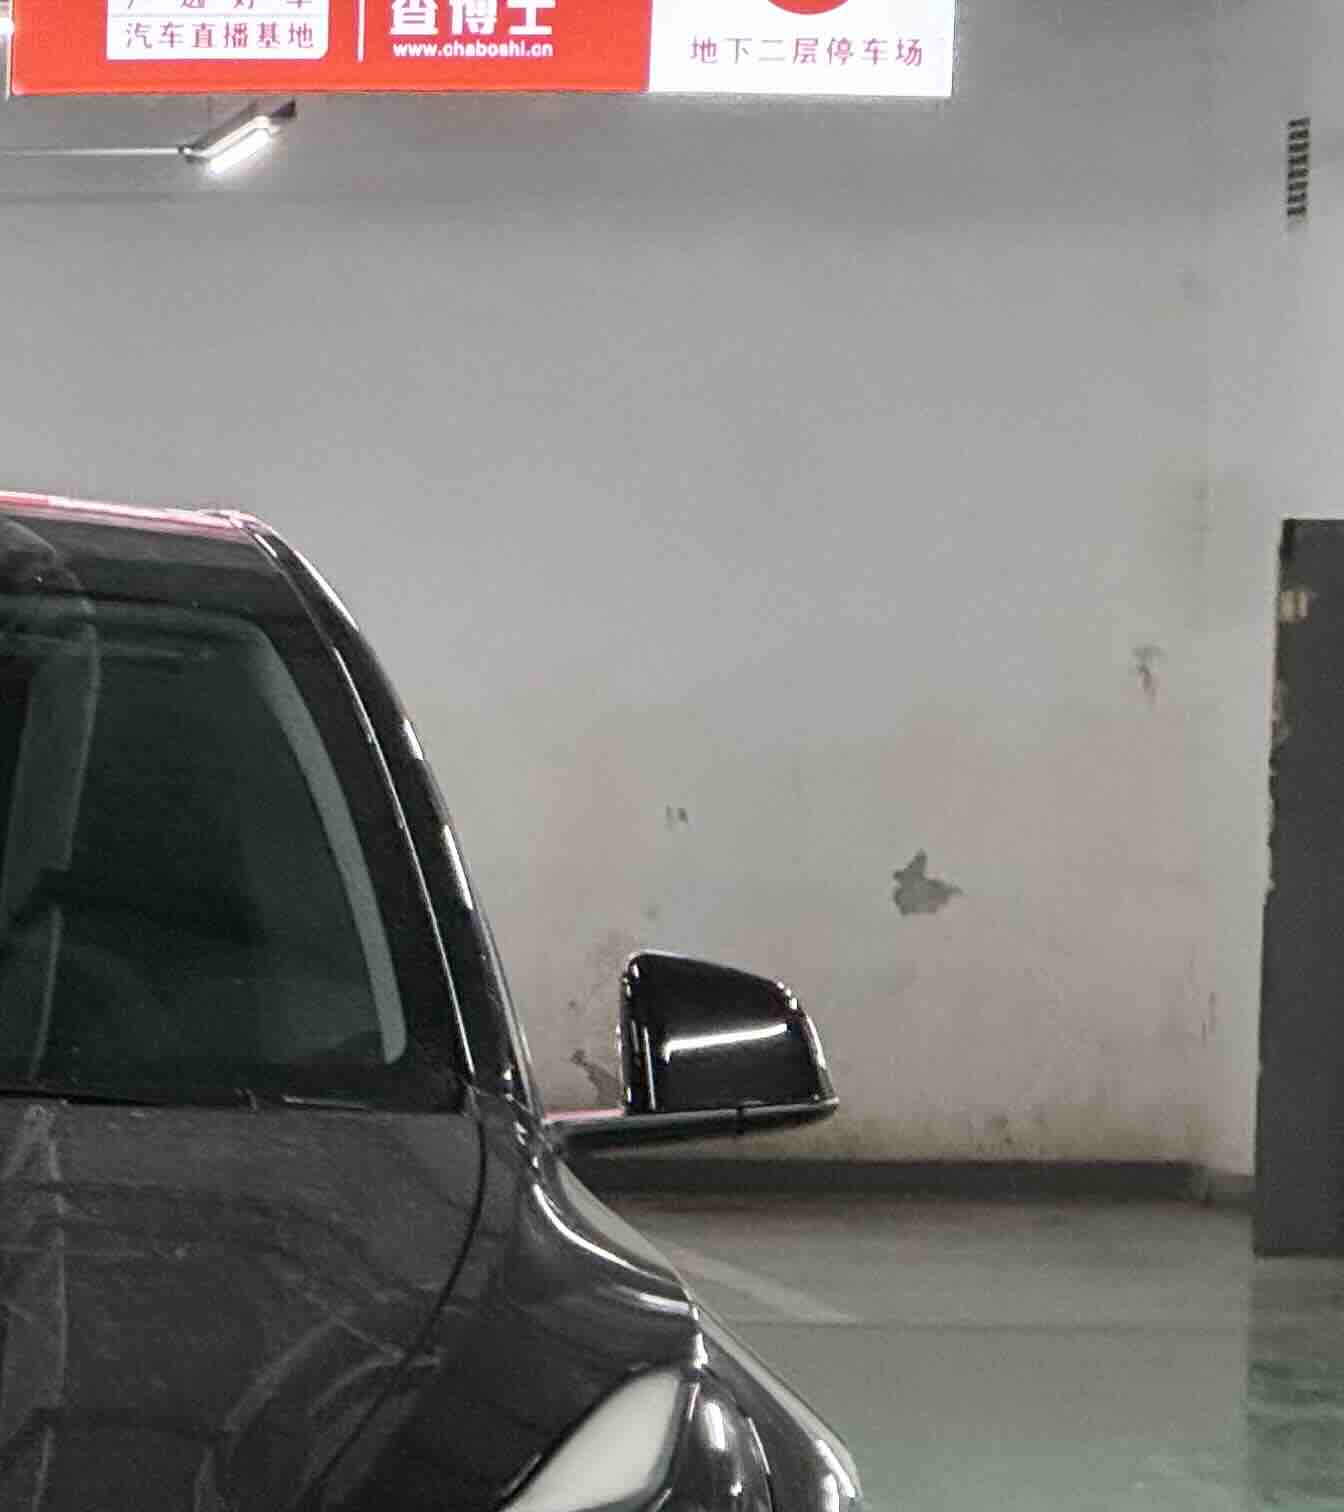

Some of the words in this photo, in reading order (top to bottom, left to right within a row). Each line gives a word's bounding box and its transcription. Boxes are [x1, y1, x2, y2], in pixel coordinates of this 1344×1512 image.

[125, 22, 315, 49] 汽车直播基地
[392, 40, 554, 58] www.chaboshi.cn
[690, 36, 923, 66] 地下二层停车场
